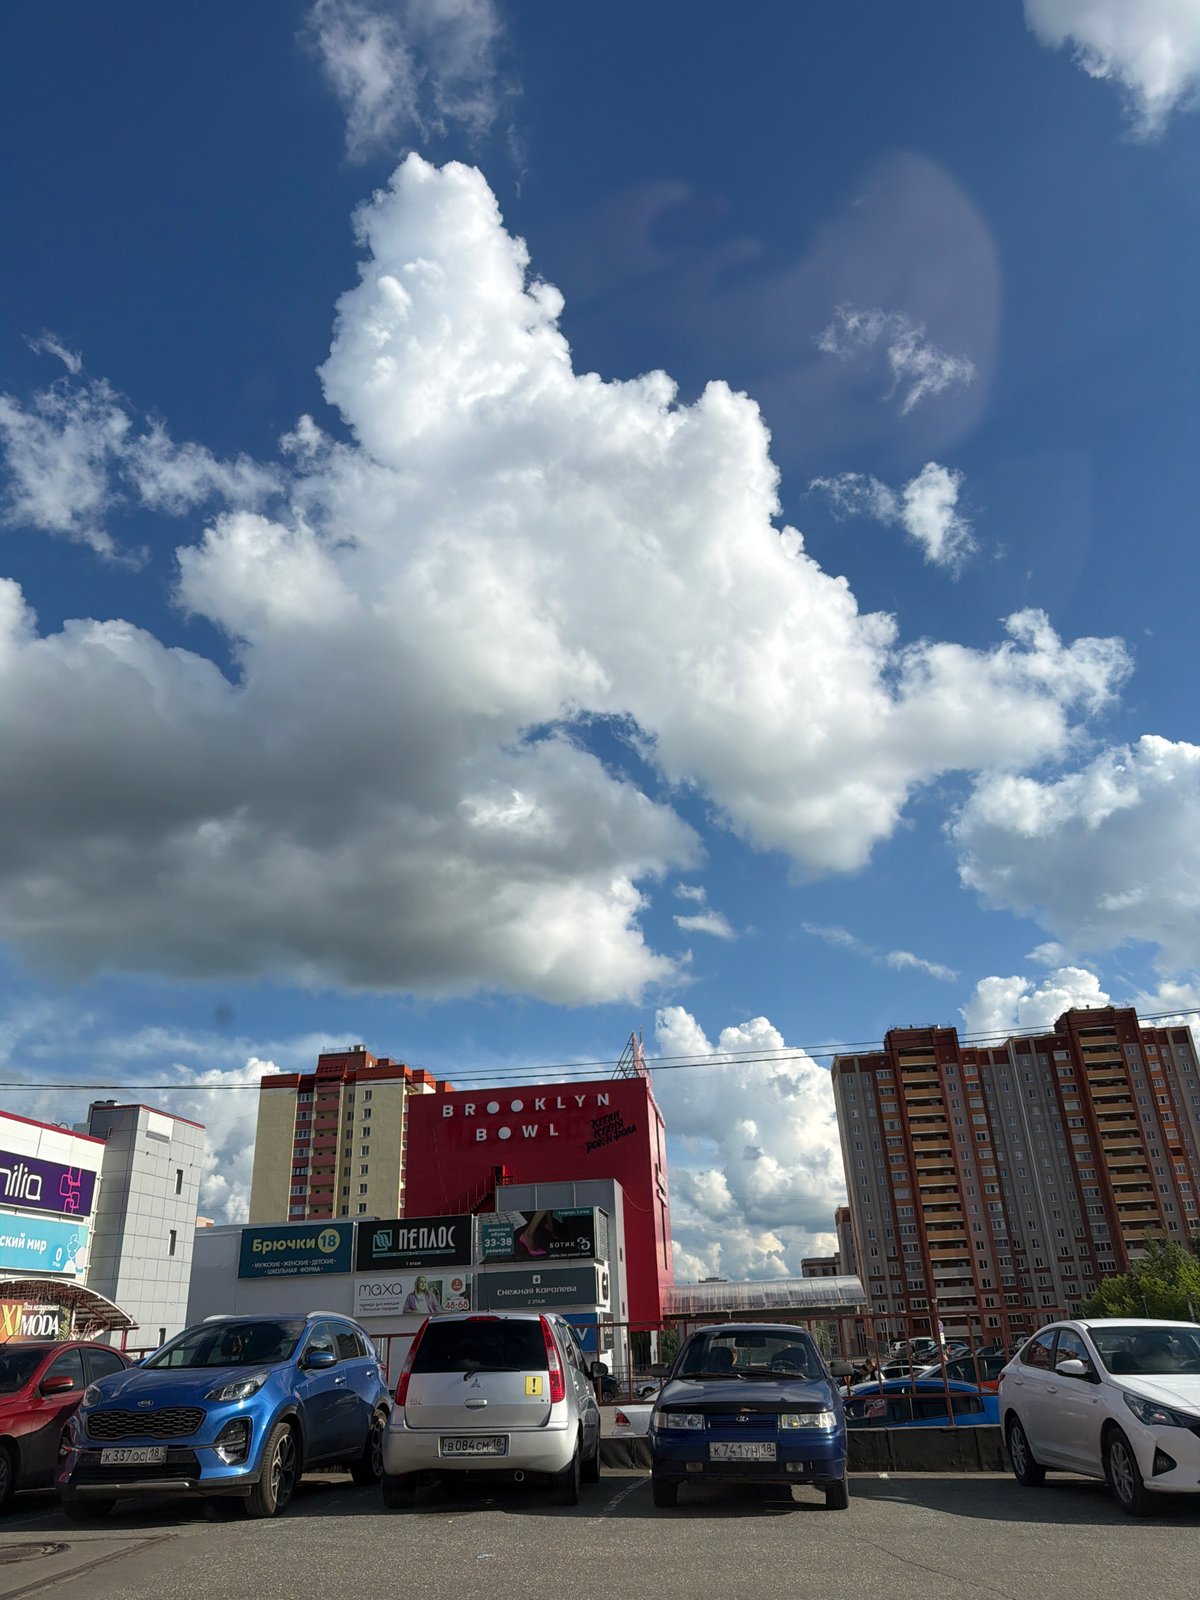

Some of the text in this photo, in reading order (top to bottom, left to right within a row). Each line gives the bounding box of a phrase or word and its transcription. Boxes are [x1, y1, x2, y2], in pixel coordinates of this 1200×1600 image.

[442, 1092, 610, 1118] BROOKLYN
[475, 1123, 559, 1142] BOWL
[27, 1239, 47, 1255] мир
[252, 1234, 337, 1254] Брючки 18
[398, 1226, 456, 1250] ПЕПЛОС
[484, 1237, 512, 1247] 33-38
[549, 1241, 575, 1249] БОТИК
[20, 1314, 59, 1336] MODA
